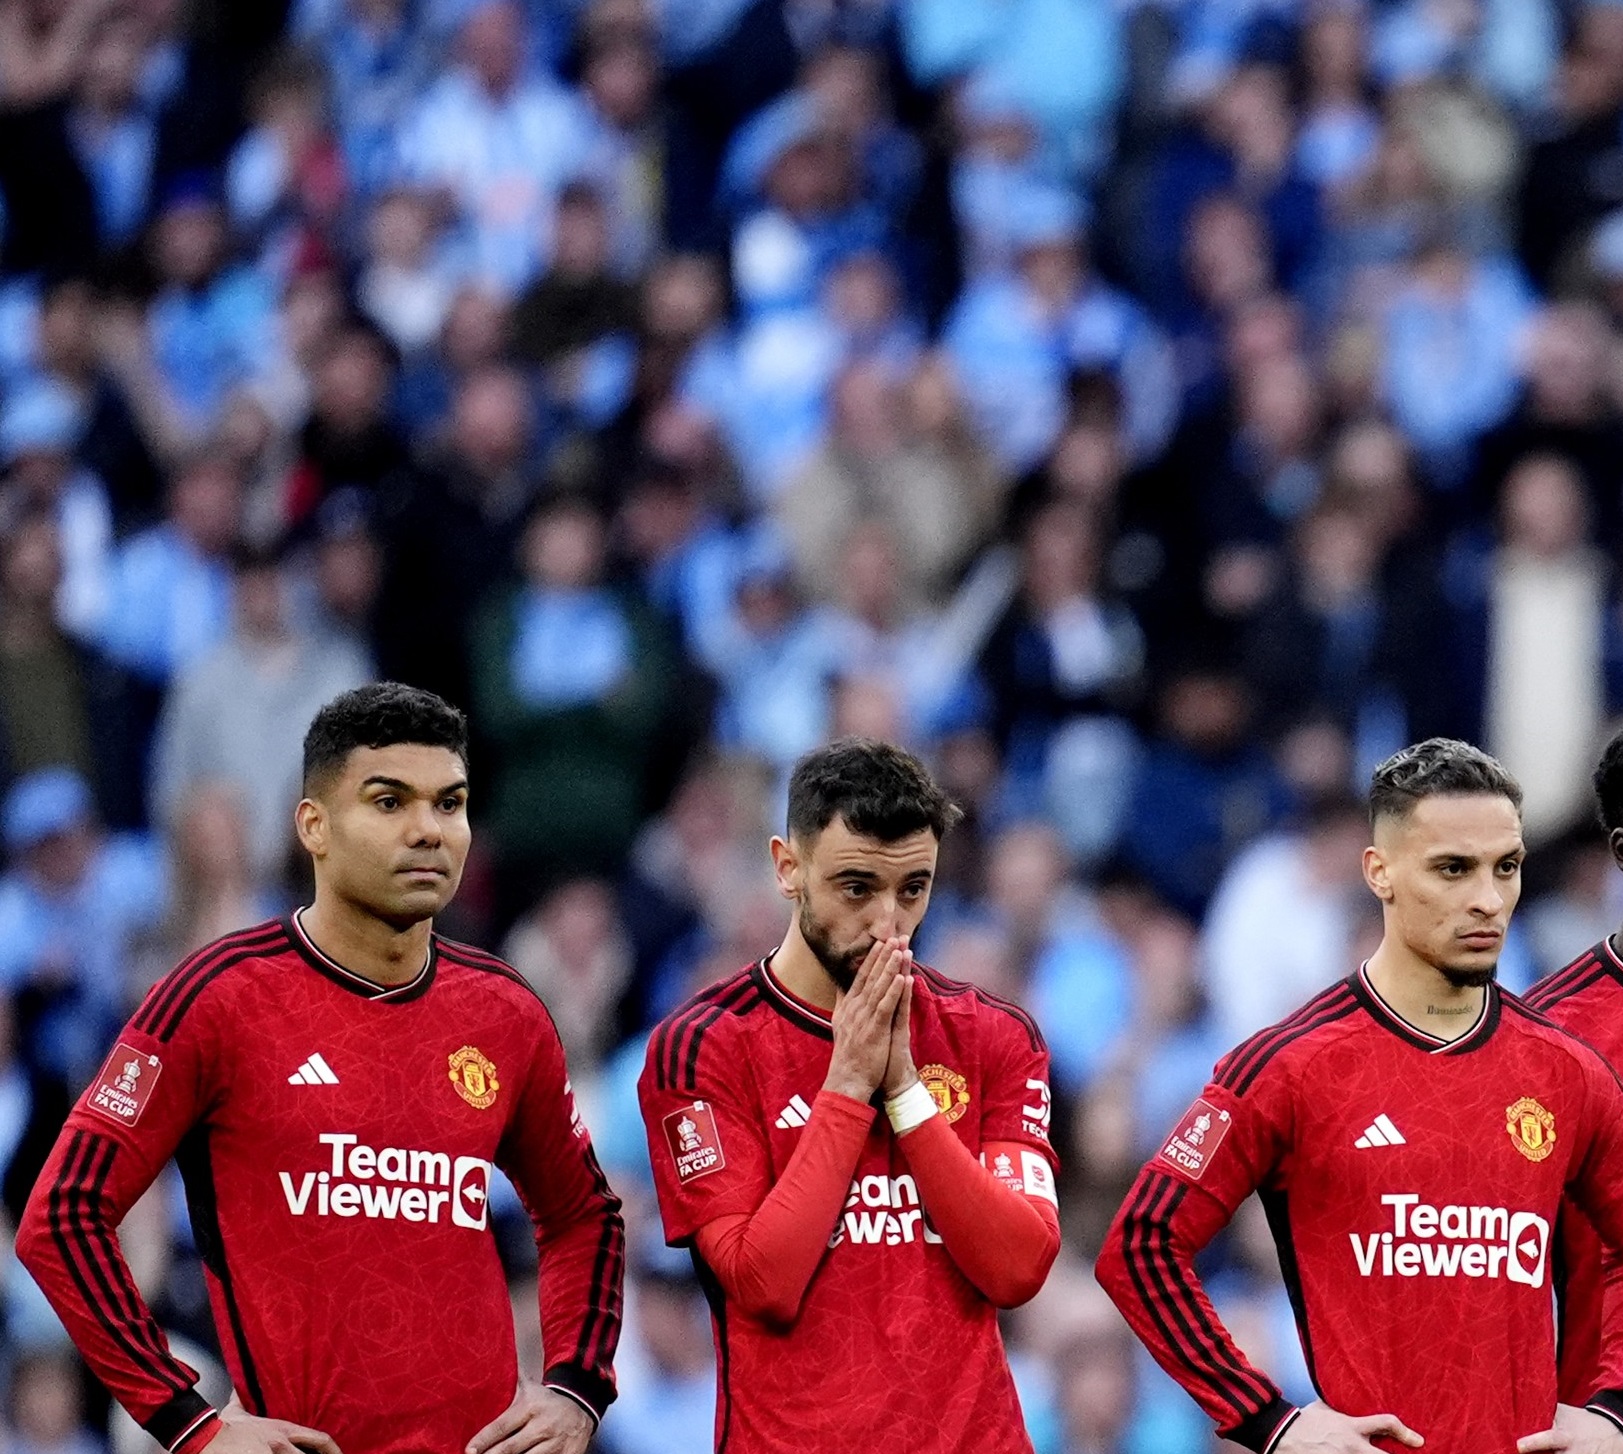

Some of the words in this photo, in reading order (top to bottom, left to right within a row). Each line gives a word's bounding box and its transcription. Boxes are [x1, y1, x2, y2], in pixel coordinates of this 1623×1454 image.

[94, 1094, 112, 1110] FA
[109, 1099, 135, 1118] CUP
[319, 1133, 450, 1186] Team
[679, 1161, 696, 1178] FA
[693, 1154, 718, 1173] CUP
[1164, 1145, 1178, 1160] FA
[1177, 1152, 1200, 1171] CUP
[278, 1172, 449, 1224] Viewer
[1381, 1193, 1508, 1241] Team
[1349, 1231, 1508, 1278] Viewer
